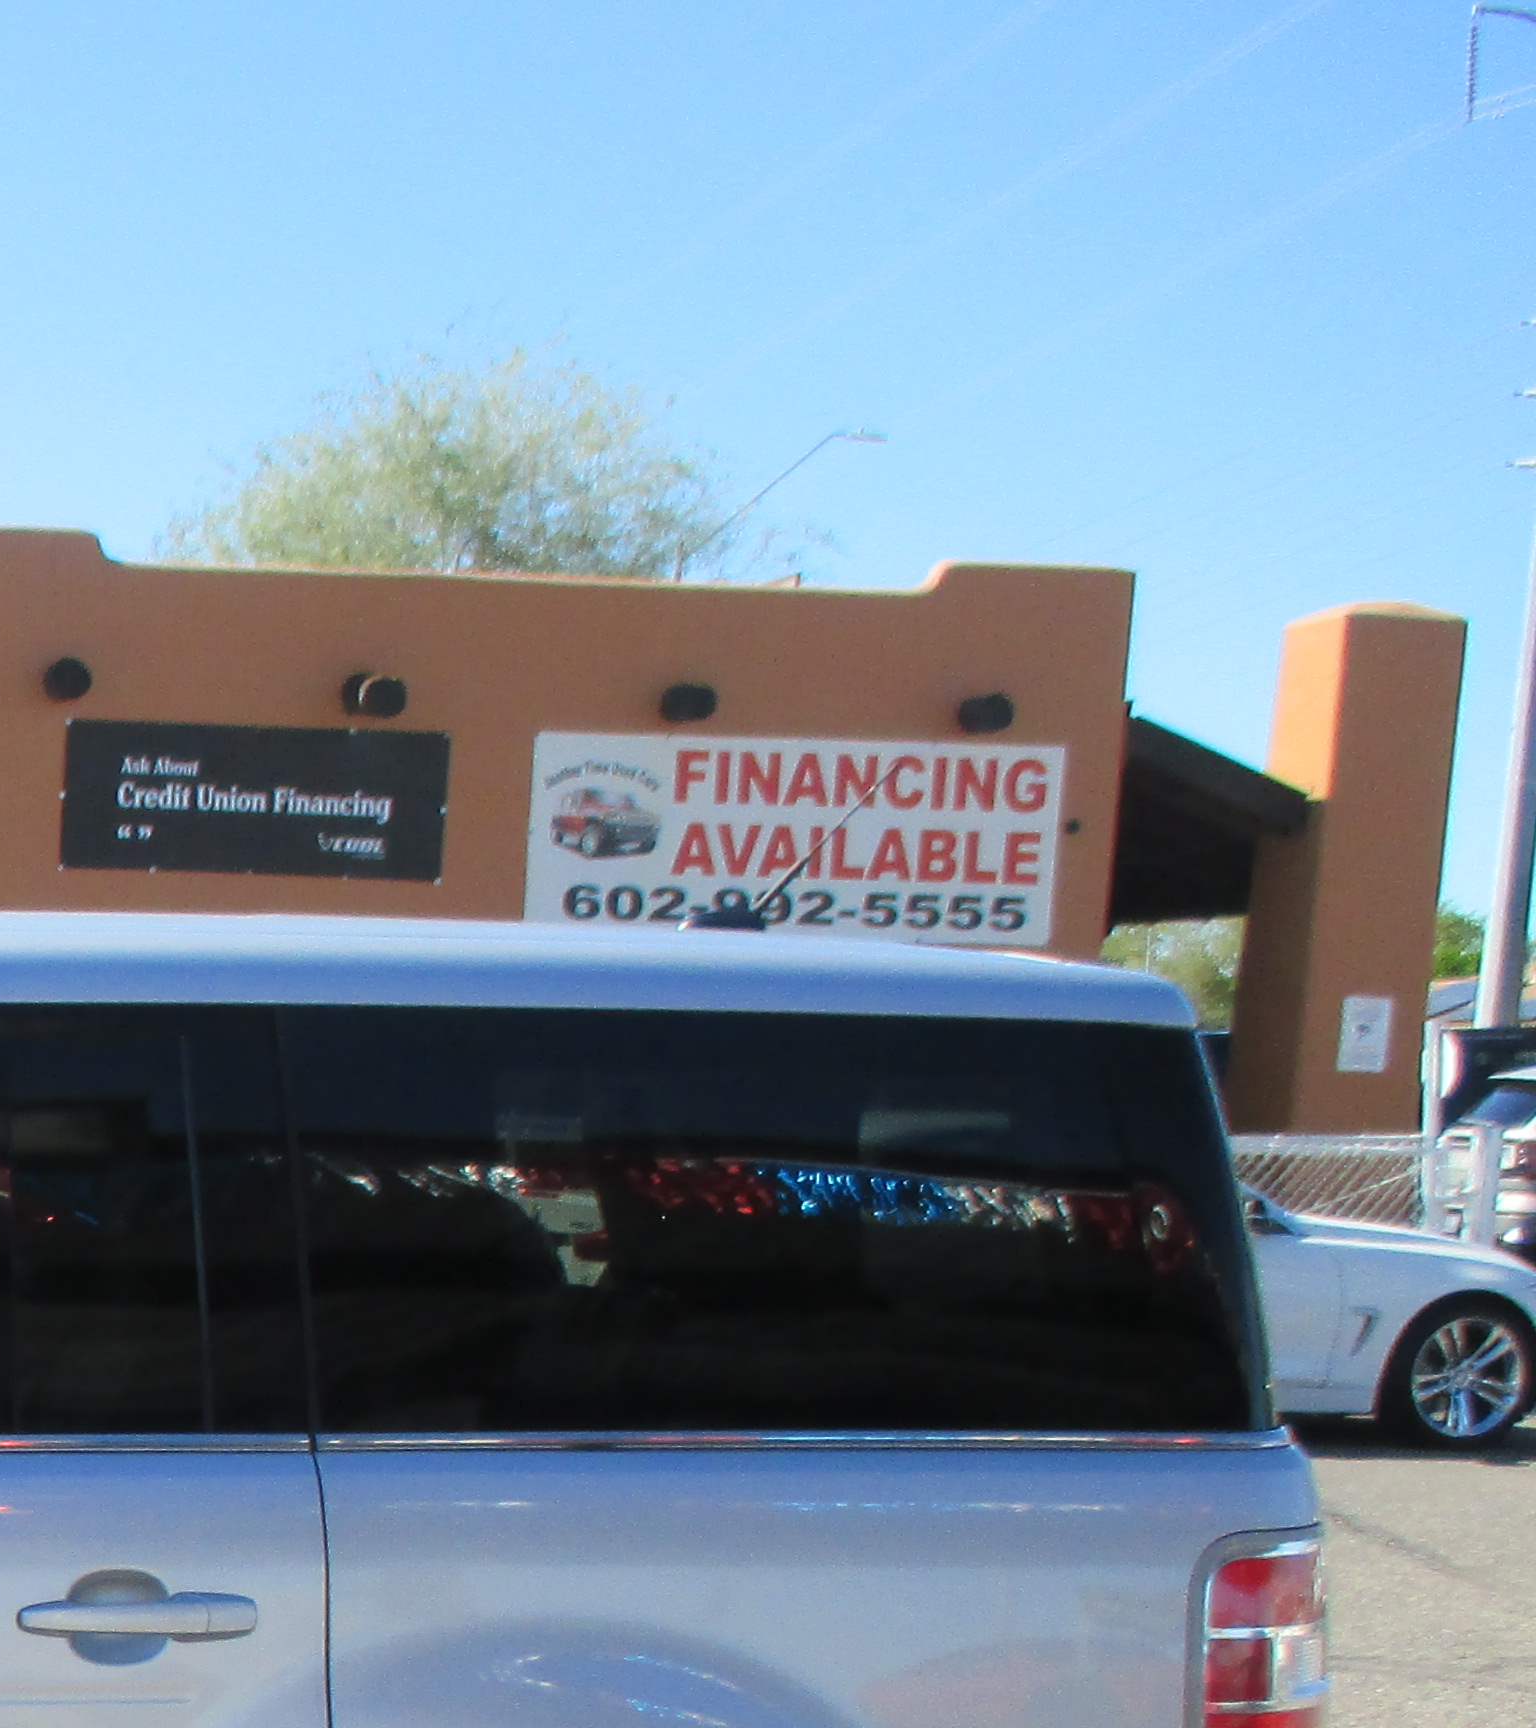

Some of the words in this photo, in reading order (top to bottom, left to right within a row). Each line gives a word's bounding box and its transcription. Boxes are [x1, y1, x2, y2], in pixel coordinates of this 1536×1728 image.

[120, 755, 151, 775] Ask
[153, 755, 200, 777] About
[673, 749, 1049, 813] FINANCING
[117, 781, 193, 811] Credit
[196, 783, 268, 812] Union
[272, 786, 394, 825] Financing
[669, 822, 1042, 885] AVAILABLE
